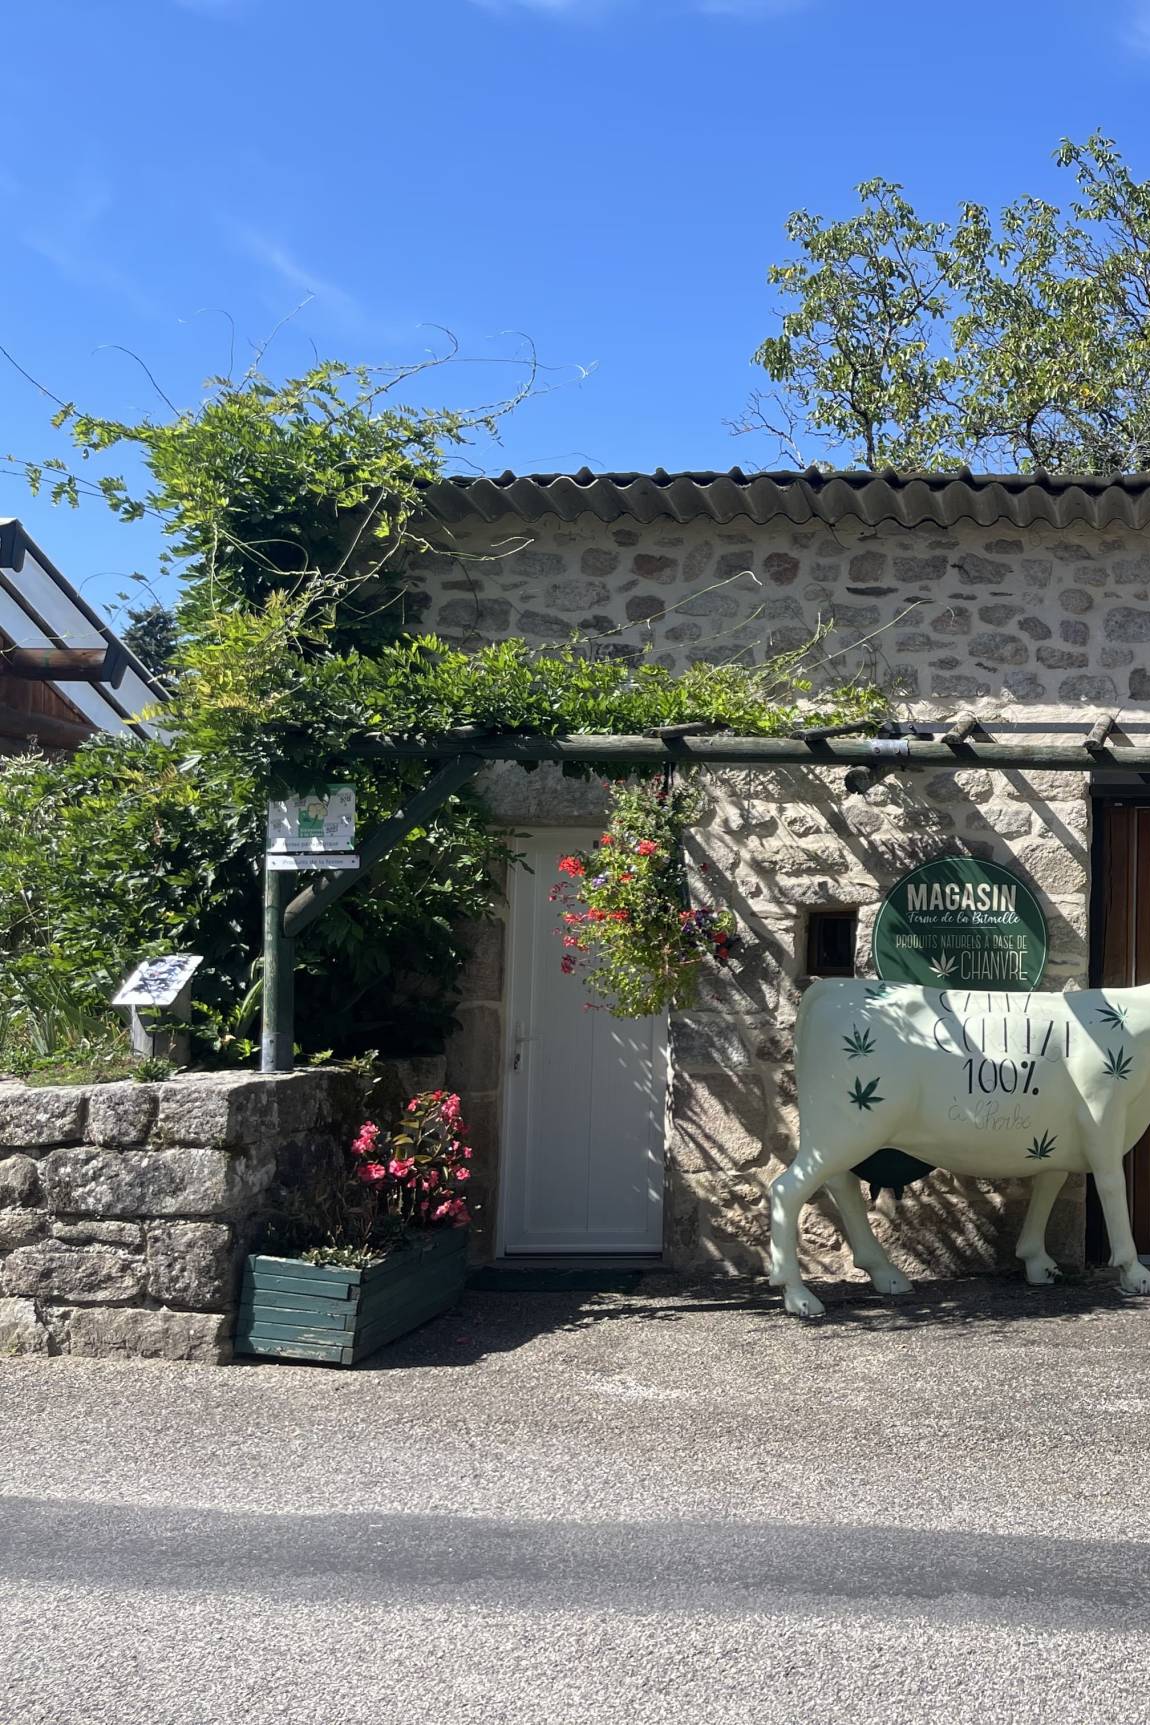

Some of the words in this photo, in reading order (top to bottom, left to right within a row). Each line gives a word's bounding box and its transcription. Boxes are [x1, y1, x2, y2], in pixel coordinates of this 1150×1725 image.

[907, 883, 1017, 912] MAGASIN
[907, 912, 938, 924] Ferme
[941, 912, 955, 924] de
[957, 912, 969, 924] la
[896, 935, 938, 949] PRODUITS
[940, 935, 982, 949] NATURELS
[993, 935, 1014, 949] BASE
[1017, 935, 1028, 949] DE
[960, 951, 1029, 981] CHANVRE
[962, 1058, 1040, 1096] 100%
